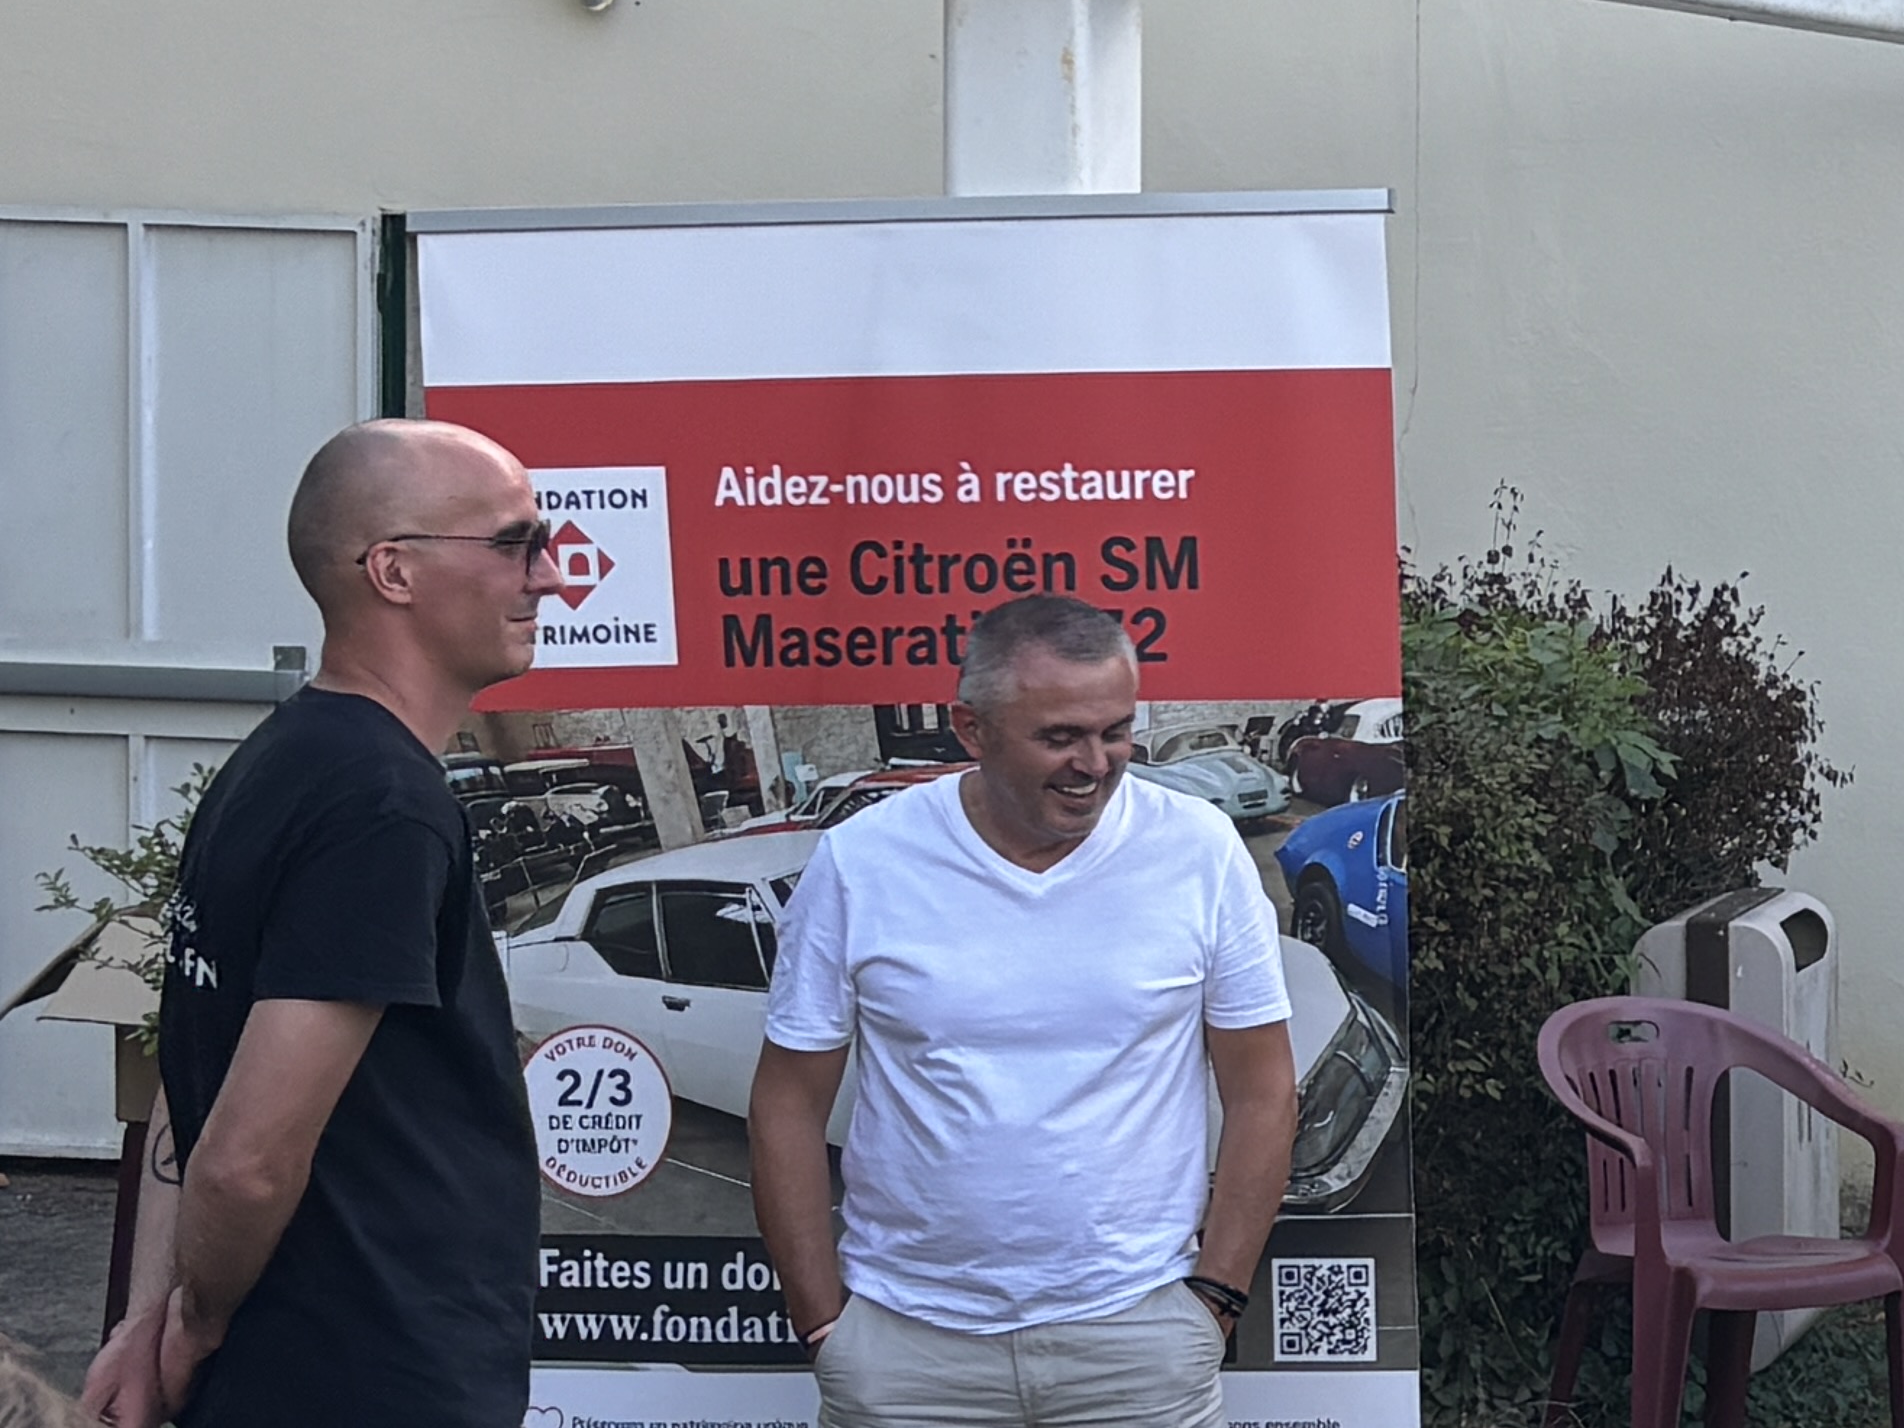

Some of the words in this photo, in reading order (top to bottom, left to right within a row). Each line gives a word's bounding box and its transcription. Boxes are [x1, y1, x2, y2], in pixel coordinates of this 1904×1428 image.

[715, 465, 944, 506] Aidez-nous
[957, 462, 981, 503] à
[996, 463, 1195, 502] restaurer
[718, 556, 828, 596] une
[850, 537, 1076, 595] Citroën
[1100, 535, 1199, 591] SM
[722, 610, 980, 667] Maserat
[544, 1035, 596, 1062] VOTRE
[602, 1036, 637, 1061] DON
[556, 1068, 633, 1109] 2/3
[549, 1114, 572, 1130] DE
[578, 1112, 642, 1130] CRÉDIT
[539, 1248, 651, 1288] Faites
[664, 1261, 708, 1289] un
[538, 1304, 799, 1343] www.fondati
